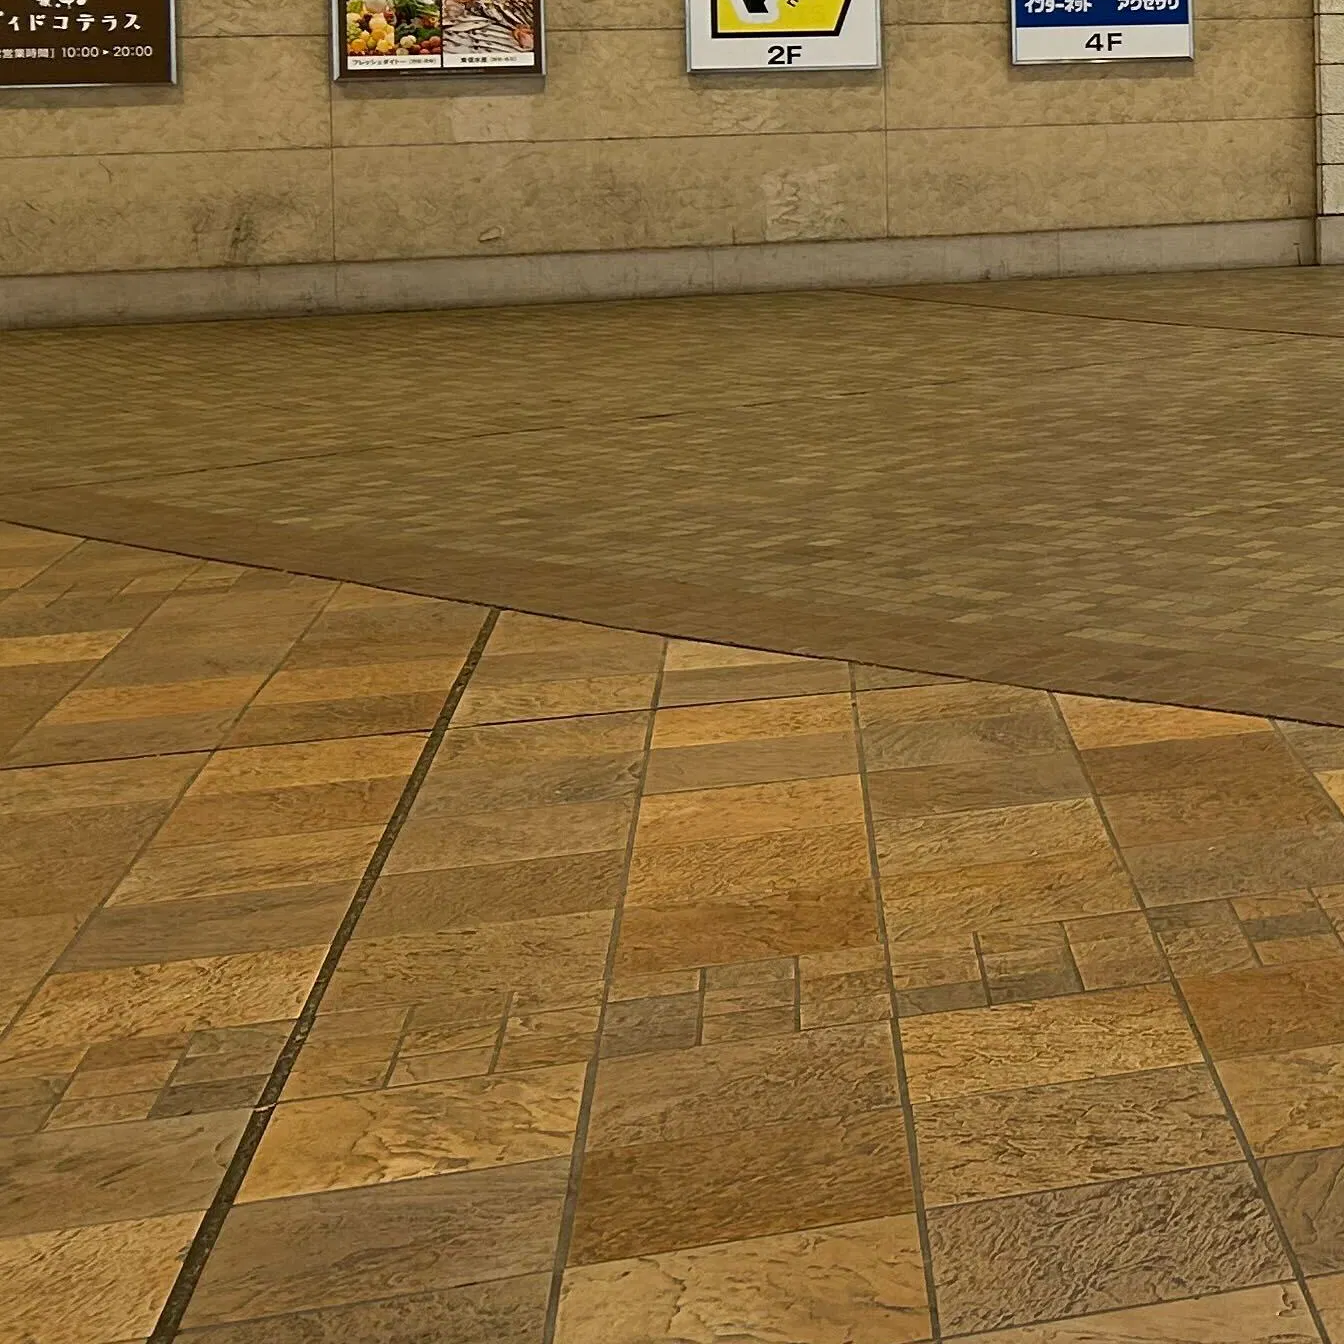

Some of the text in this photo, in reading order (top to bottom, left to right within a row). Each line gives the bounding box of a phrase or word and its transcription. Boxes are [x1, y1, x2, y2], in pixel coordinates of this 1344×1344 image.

[1085, 33, 1122, 51] 4F
[62, 46, 99, 58] 10:00
[113, 45, 152, 57] 20:00
[768, 45, 802, 65] 2F
